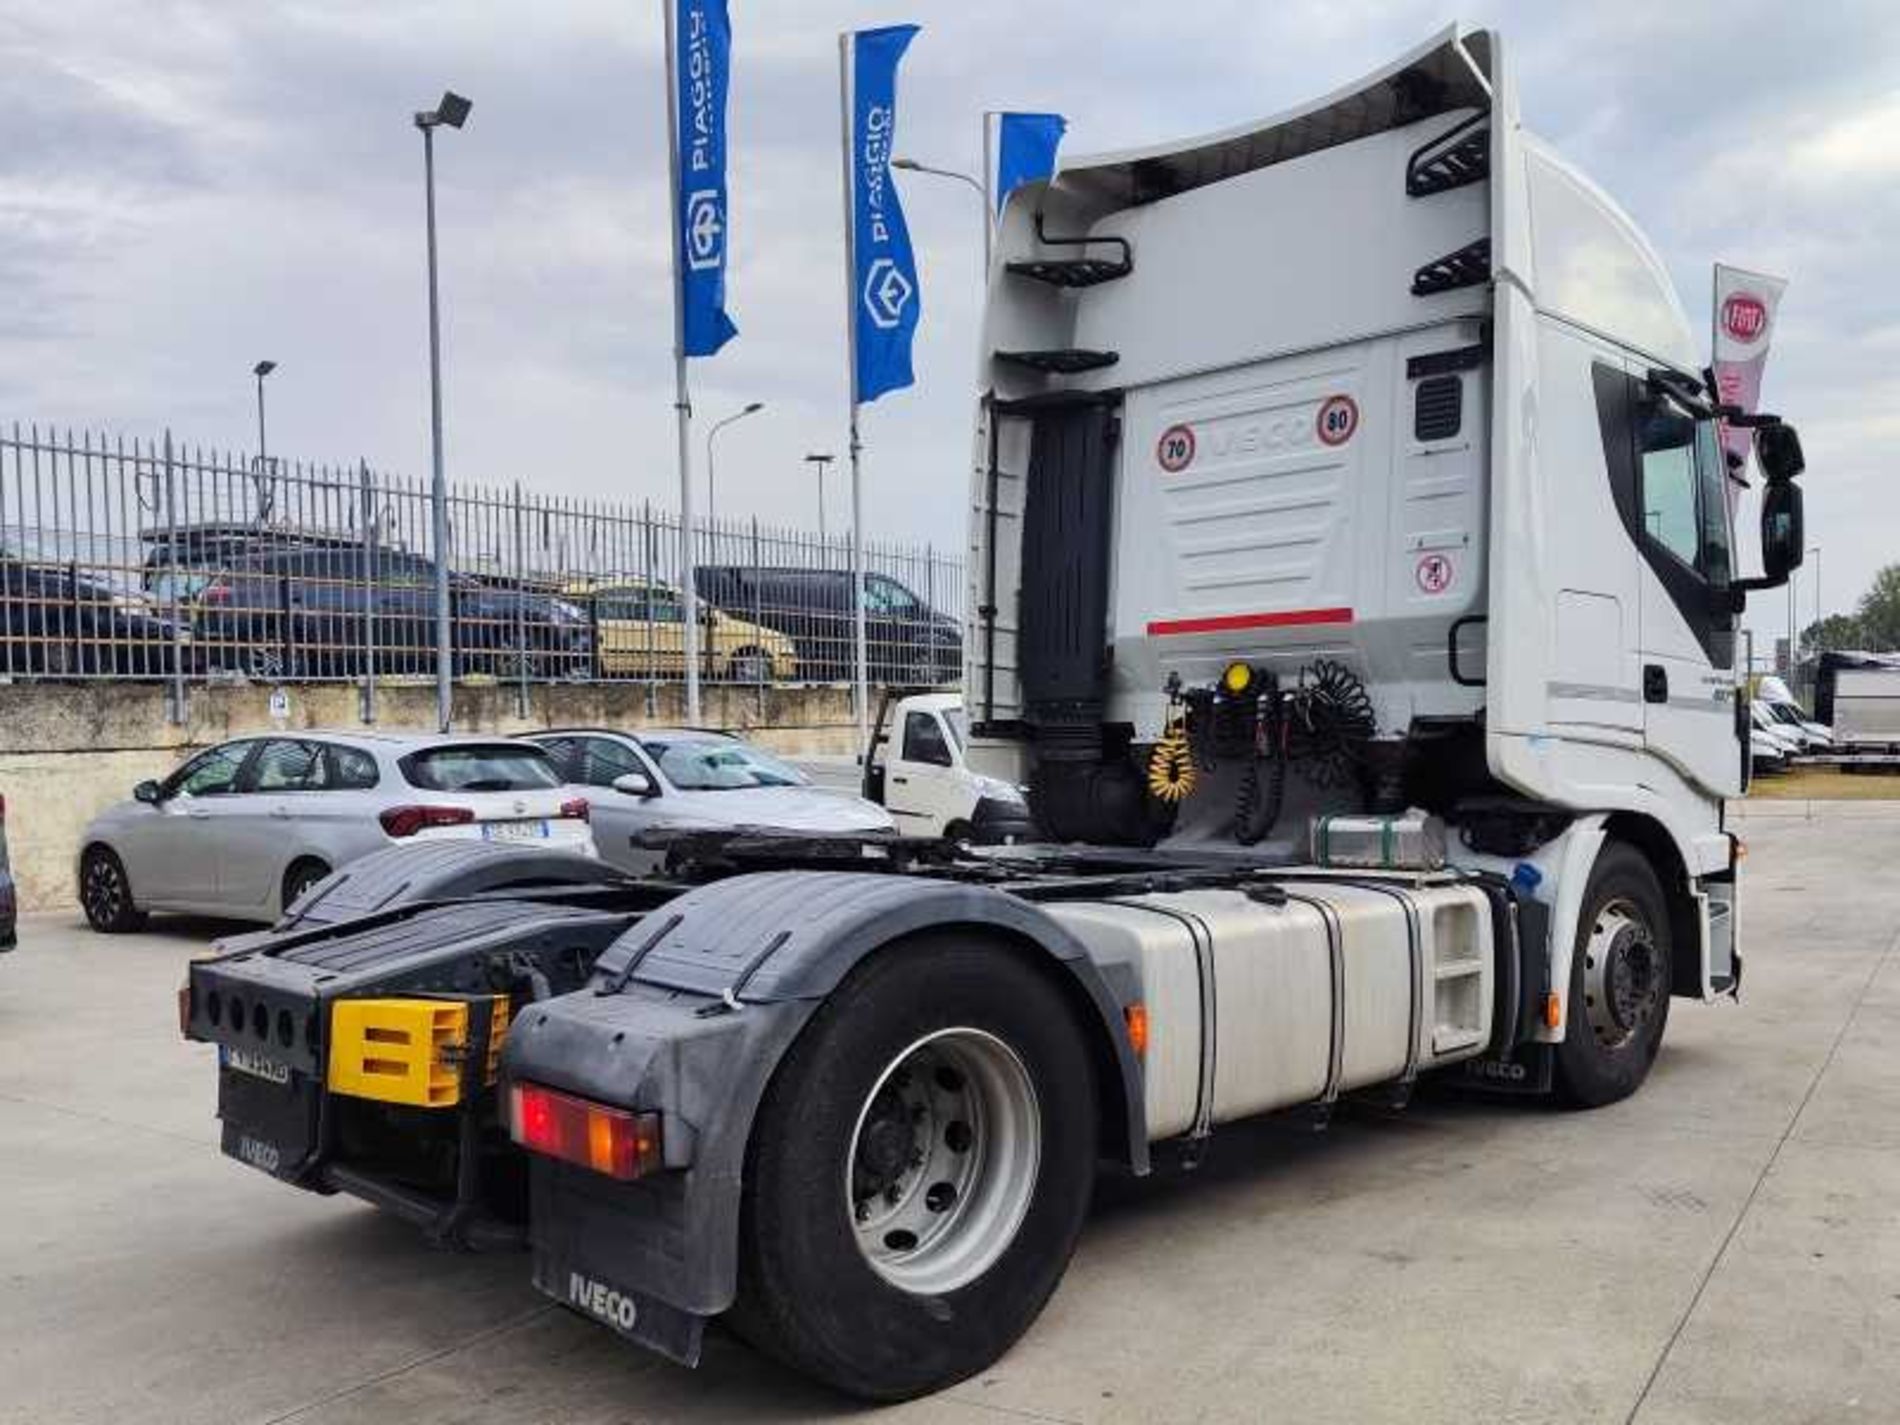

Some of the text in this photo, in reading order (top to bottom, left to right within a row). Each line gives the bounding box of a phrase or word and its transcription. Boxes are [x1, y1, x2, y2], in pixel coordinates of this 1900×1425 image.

[1729, 303, 1760, 334] FIAT
[1328, 410, 1348, 432] 80
[1167, 438, 1186, 459] 70
[570, 1271, 637, 1330] IVECO
